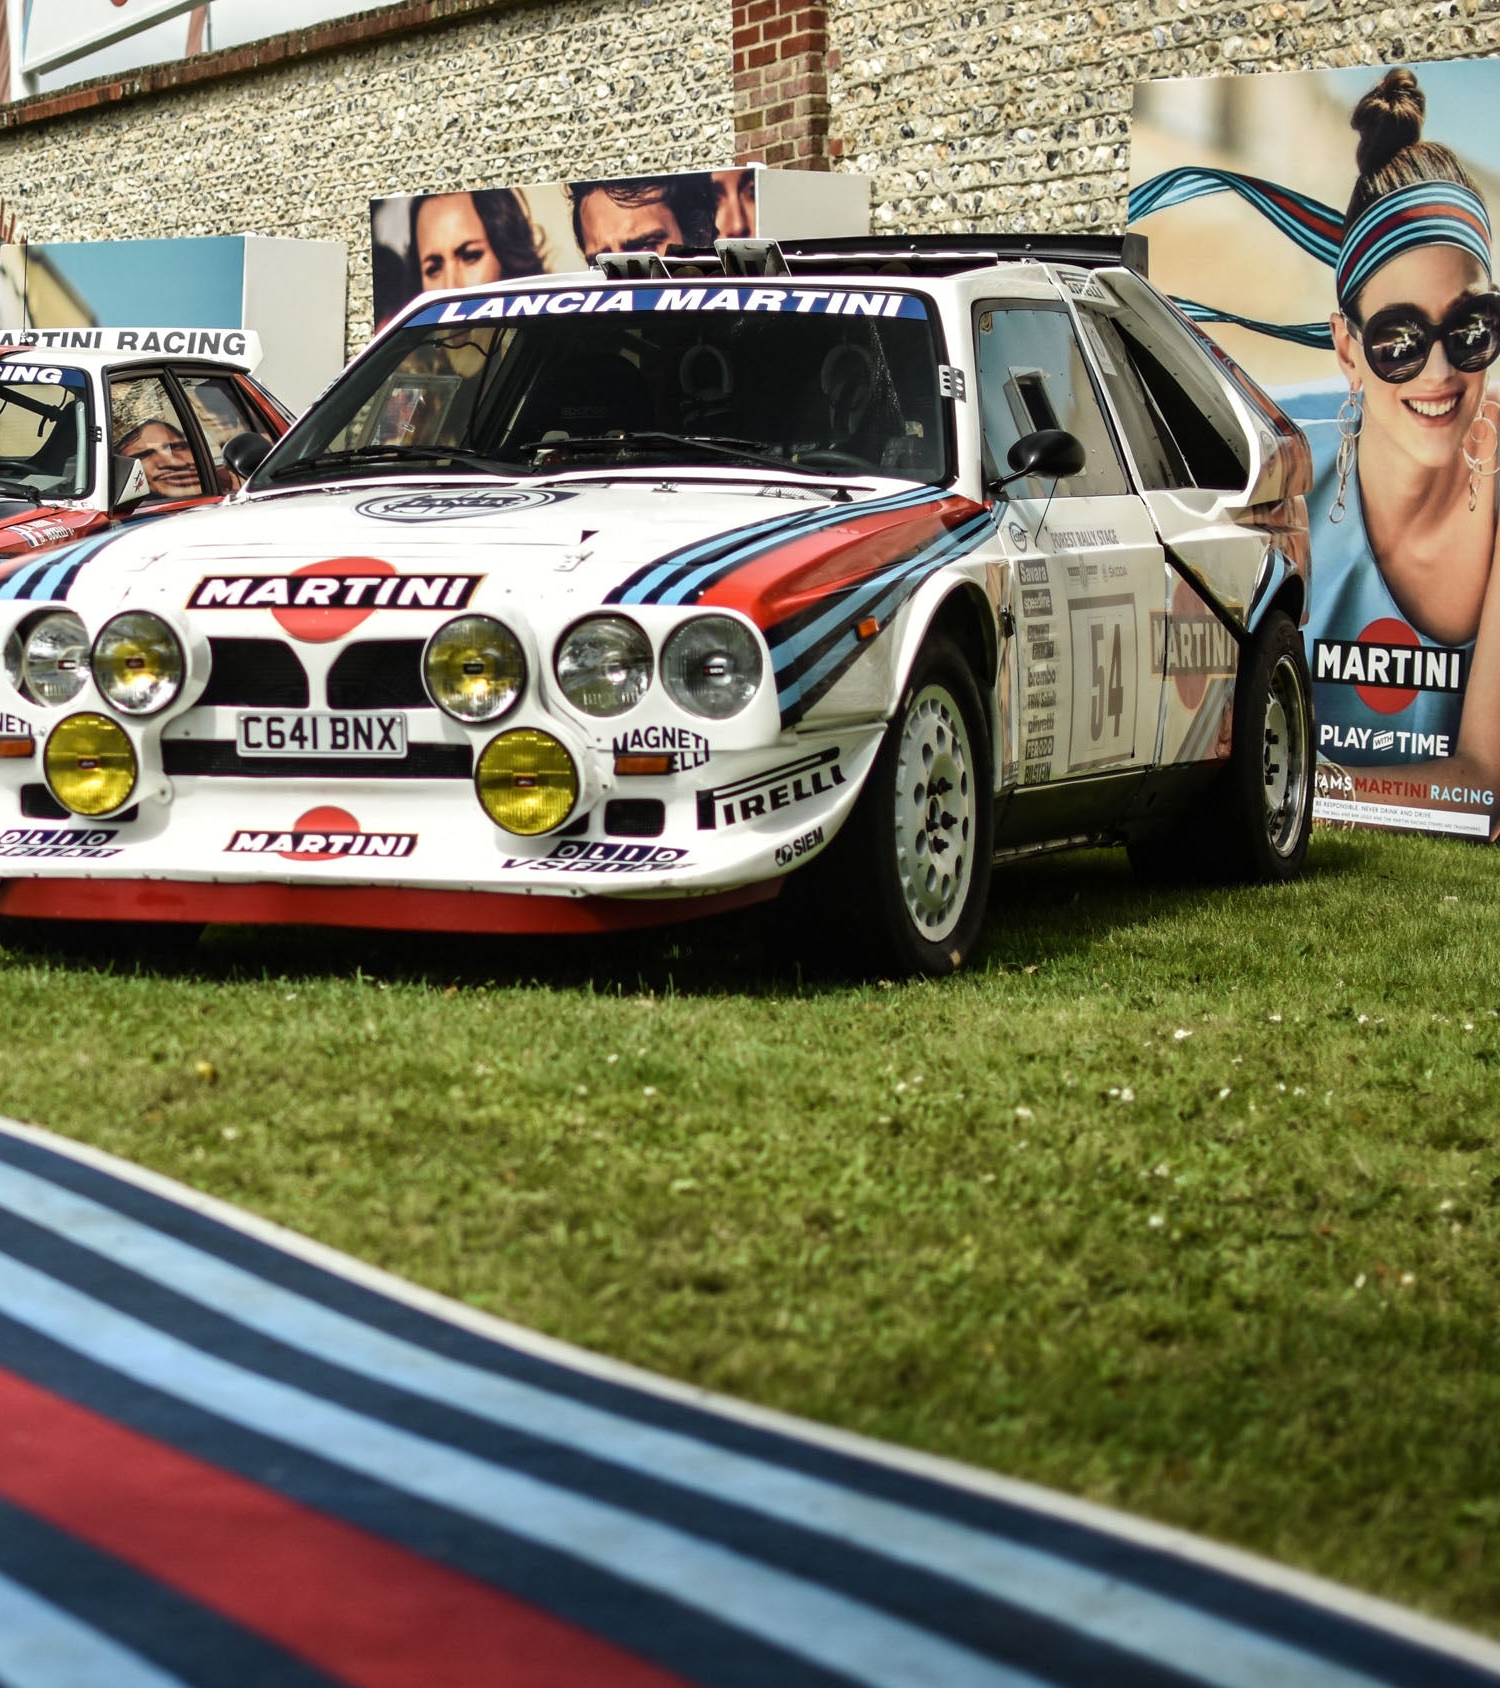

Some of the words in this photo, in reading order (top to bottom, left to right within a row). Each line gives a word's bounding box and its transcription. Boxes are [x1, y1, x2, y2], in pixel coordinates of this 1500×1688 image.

[441, 290, 639, 323] LANCIA
[654, 288, 905, 317] MARTINI
[116, 331, 247, 356] RACING
[1050, 531, 1078, 549] FOREST
[1075, 530, 1098, 547] RALLY
[1099, 528, 1120, 546] STAGE
[1019, 562, 1047, 584] Savara
[196, 577, 472, 607] MARTINI
[1153, 619, 1233, 668] MARTINI
[1027, 663, 1056, 687] brembo
[1317, 644, 1461, 689] MARTINI
[1090, 623, 1124, 742] 54
[244, 716, 320, 750] C641
[330, 717, 397, 751] BNX
[612, 726, 709, 752] MAGNETI
[1320, 724, 1372, 749] PLAY
[1374, 733, 1393, 746] WITH
[1396, 731, 1449, 757] TIME
[696, 746, 847, 831] PIRELLI
[1355, 777, 1427, 799] MARTINI
[1430, 785, 1495, 805] RACING
[0, 831, 110, 846] OLIO
[231, 833, 412, 856] MARTINI
[556, 843, 679, 862] OLIO
[792, 825, 825, 857] SIEM
